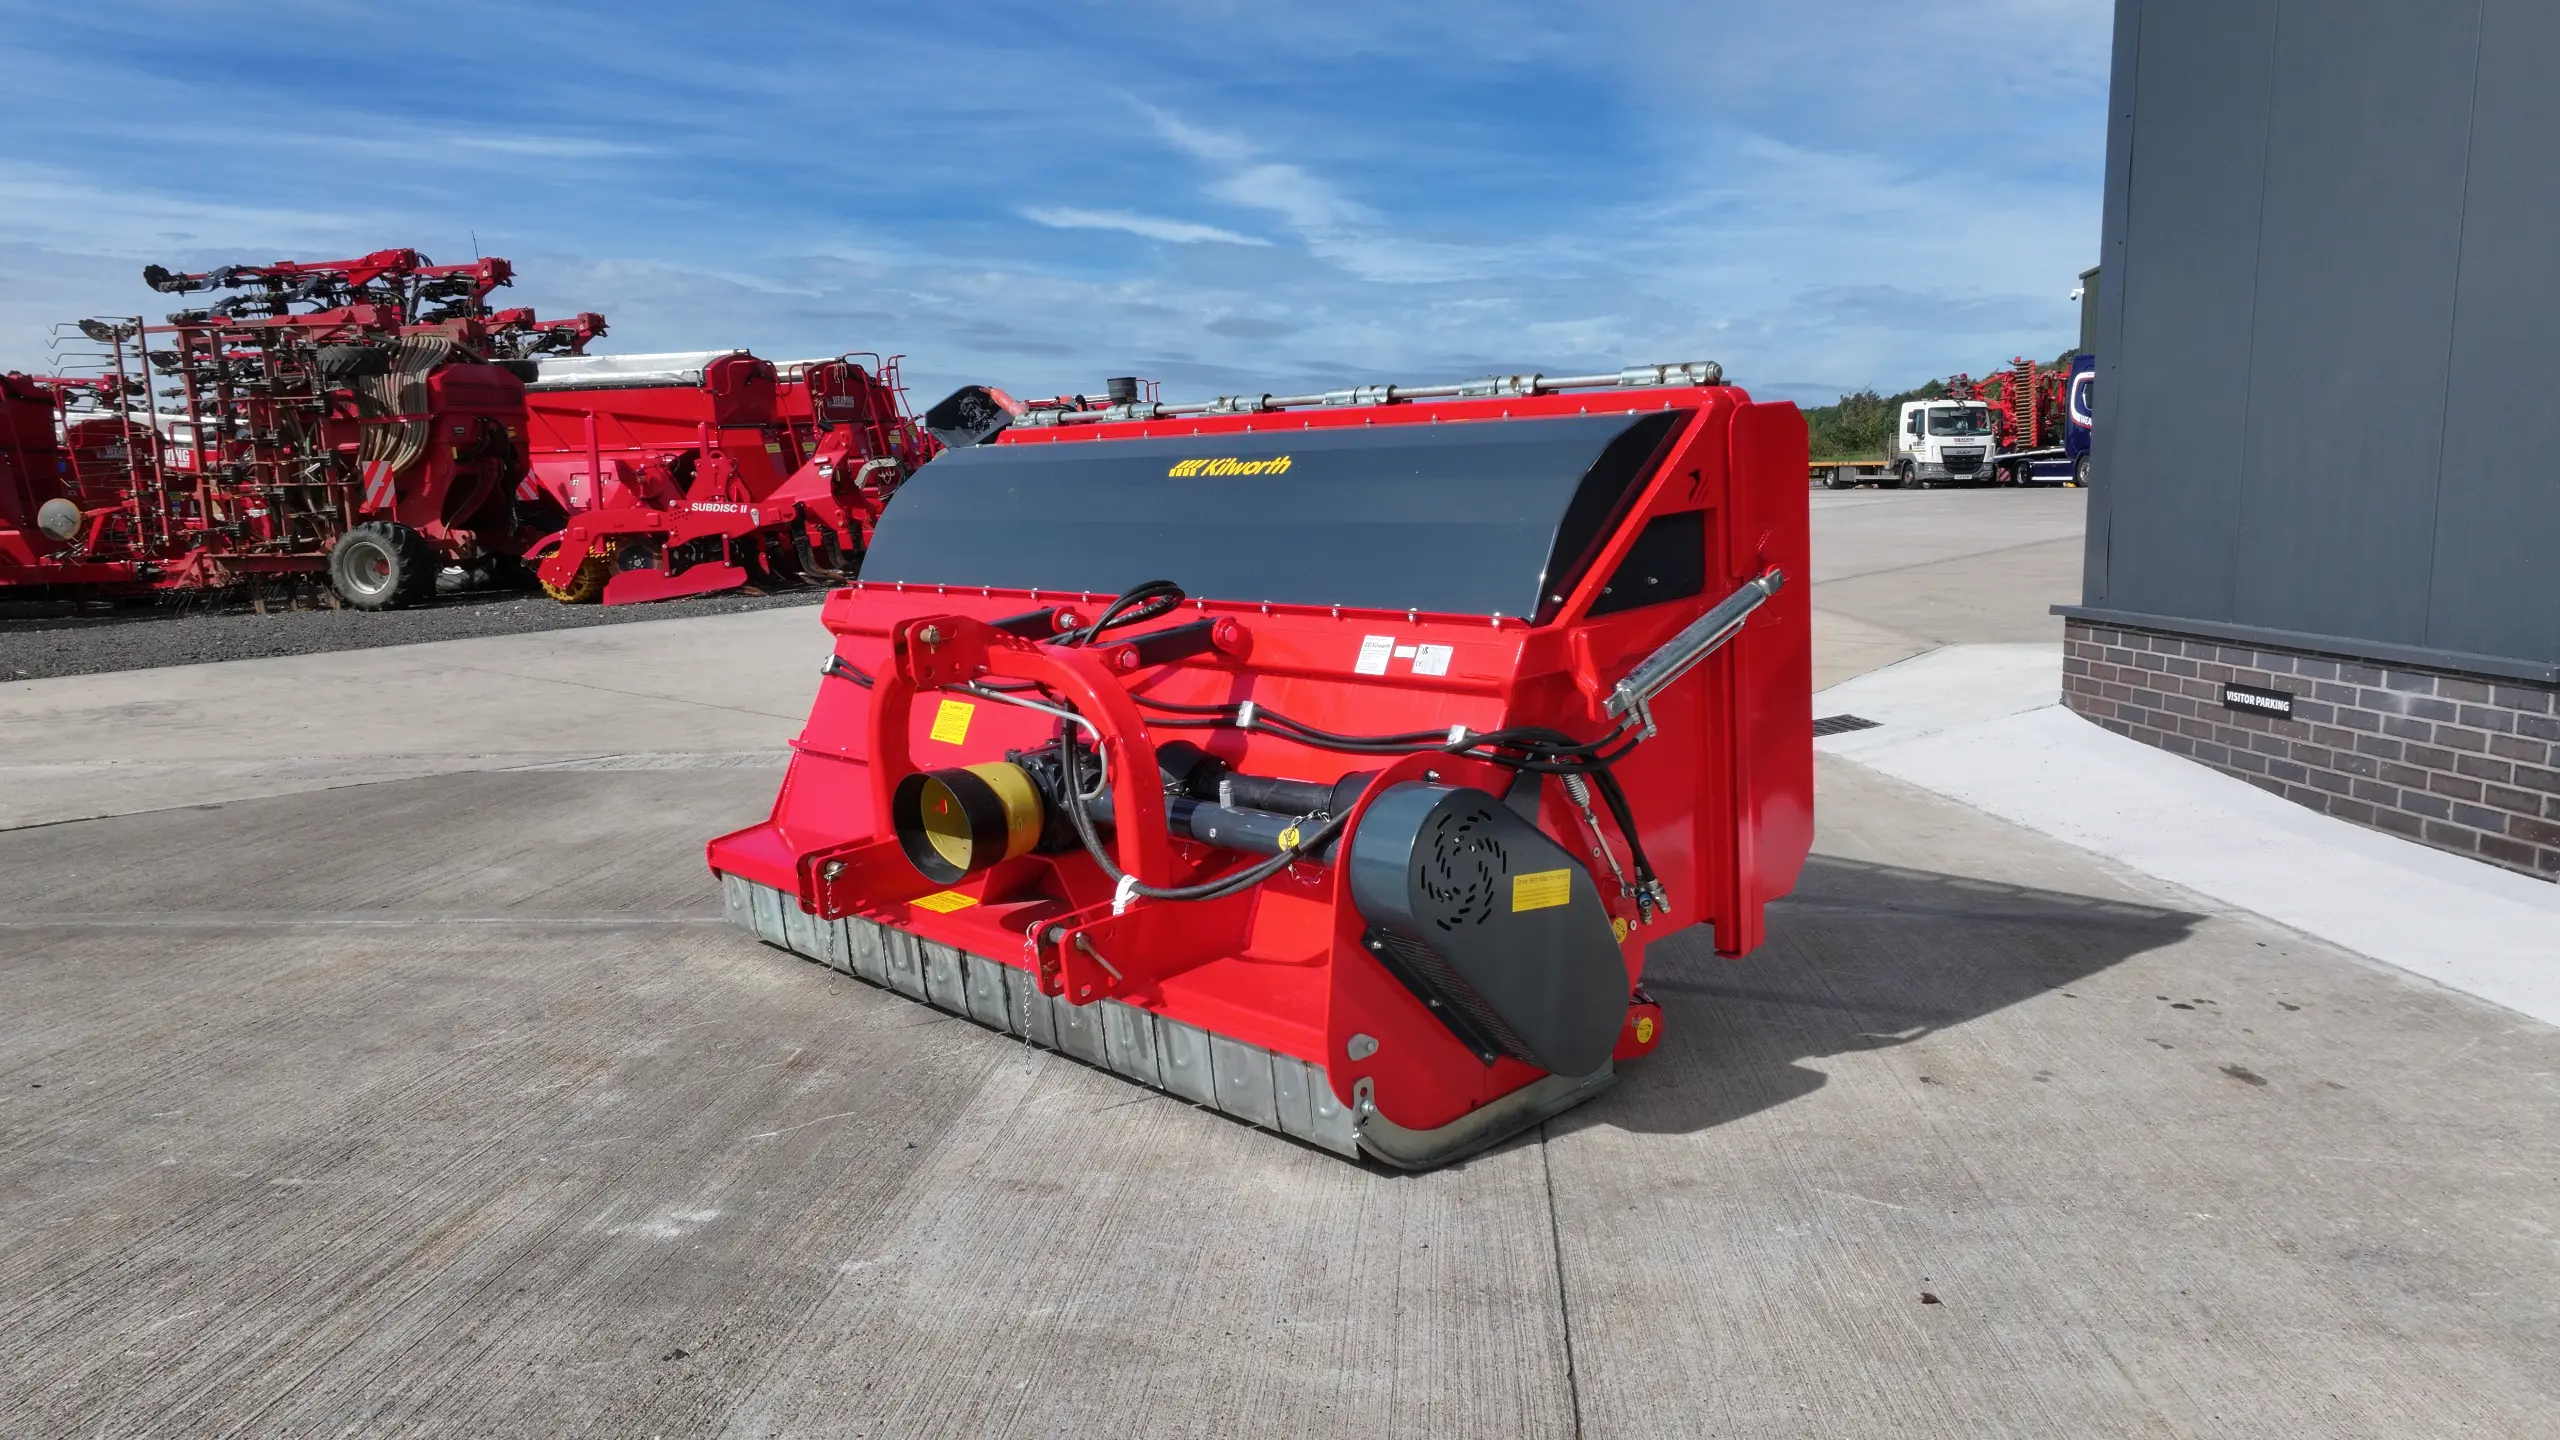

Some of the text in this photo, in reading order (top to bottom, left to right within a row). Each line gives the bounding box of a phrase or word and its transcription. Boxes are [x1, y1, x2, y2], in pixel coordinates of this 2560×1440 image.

[2081, 415, 2092, 426] WEA
[1201, 456, 1292, 477] Kilworth
[691, 502, 738, 513] SUBDISC
[2226, 690, 2290, 712] VISITOR PARKING
